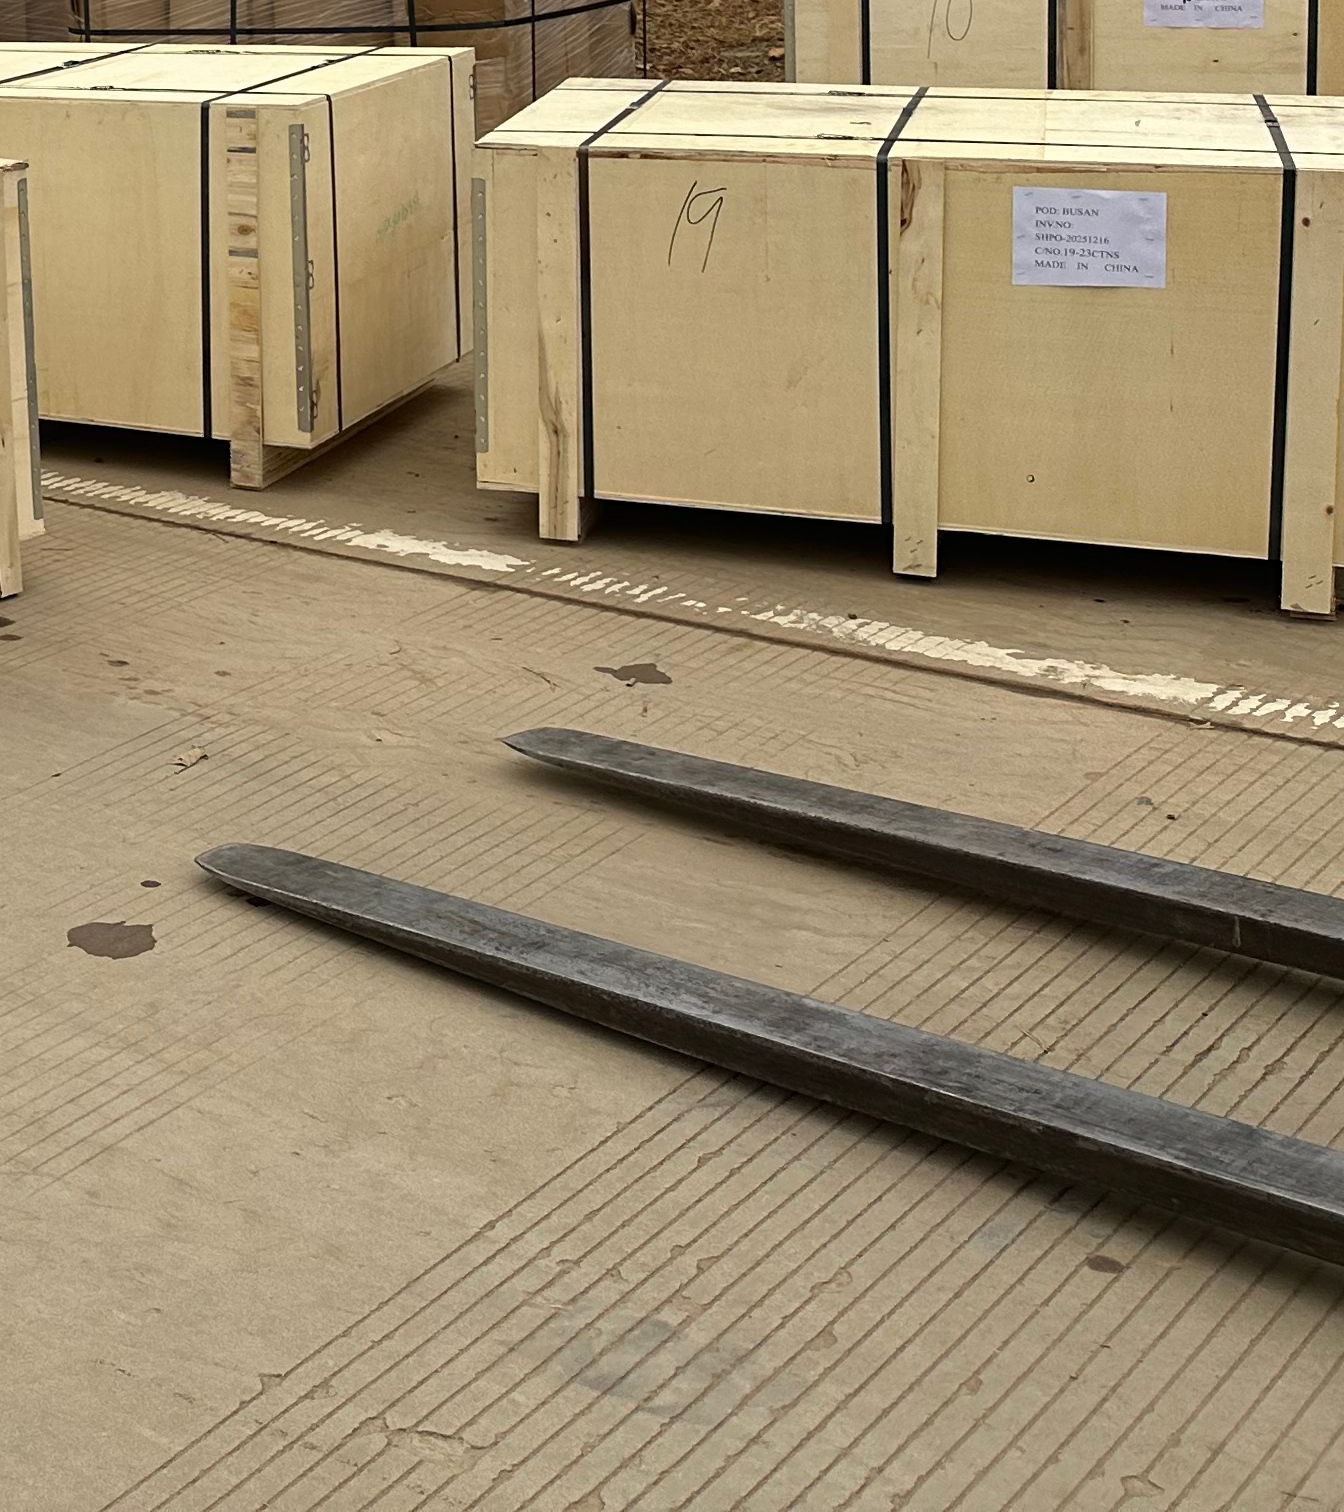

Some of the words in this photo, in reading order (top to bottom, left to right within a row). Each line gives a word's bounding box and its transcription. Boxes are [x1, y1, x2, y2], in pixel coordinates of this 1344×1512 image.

[1214, 4, 1243, 12] CHINA
[1034, 205, 1060, 216] POD:
[1062, 206, 1100, 217] BUSAN
[667, 180, 728, 273] 19
[1034, 233, 1110, 245] SHPO-20251216
[1034, 259, 1067, 270] MADE
[1076, 262, 1090, 271] IN
[1103, 263, 1140, 273] CHINA
